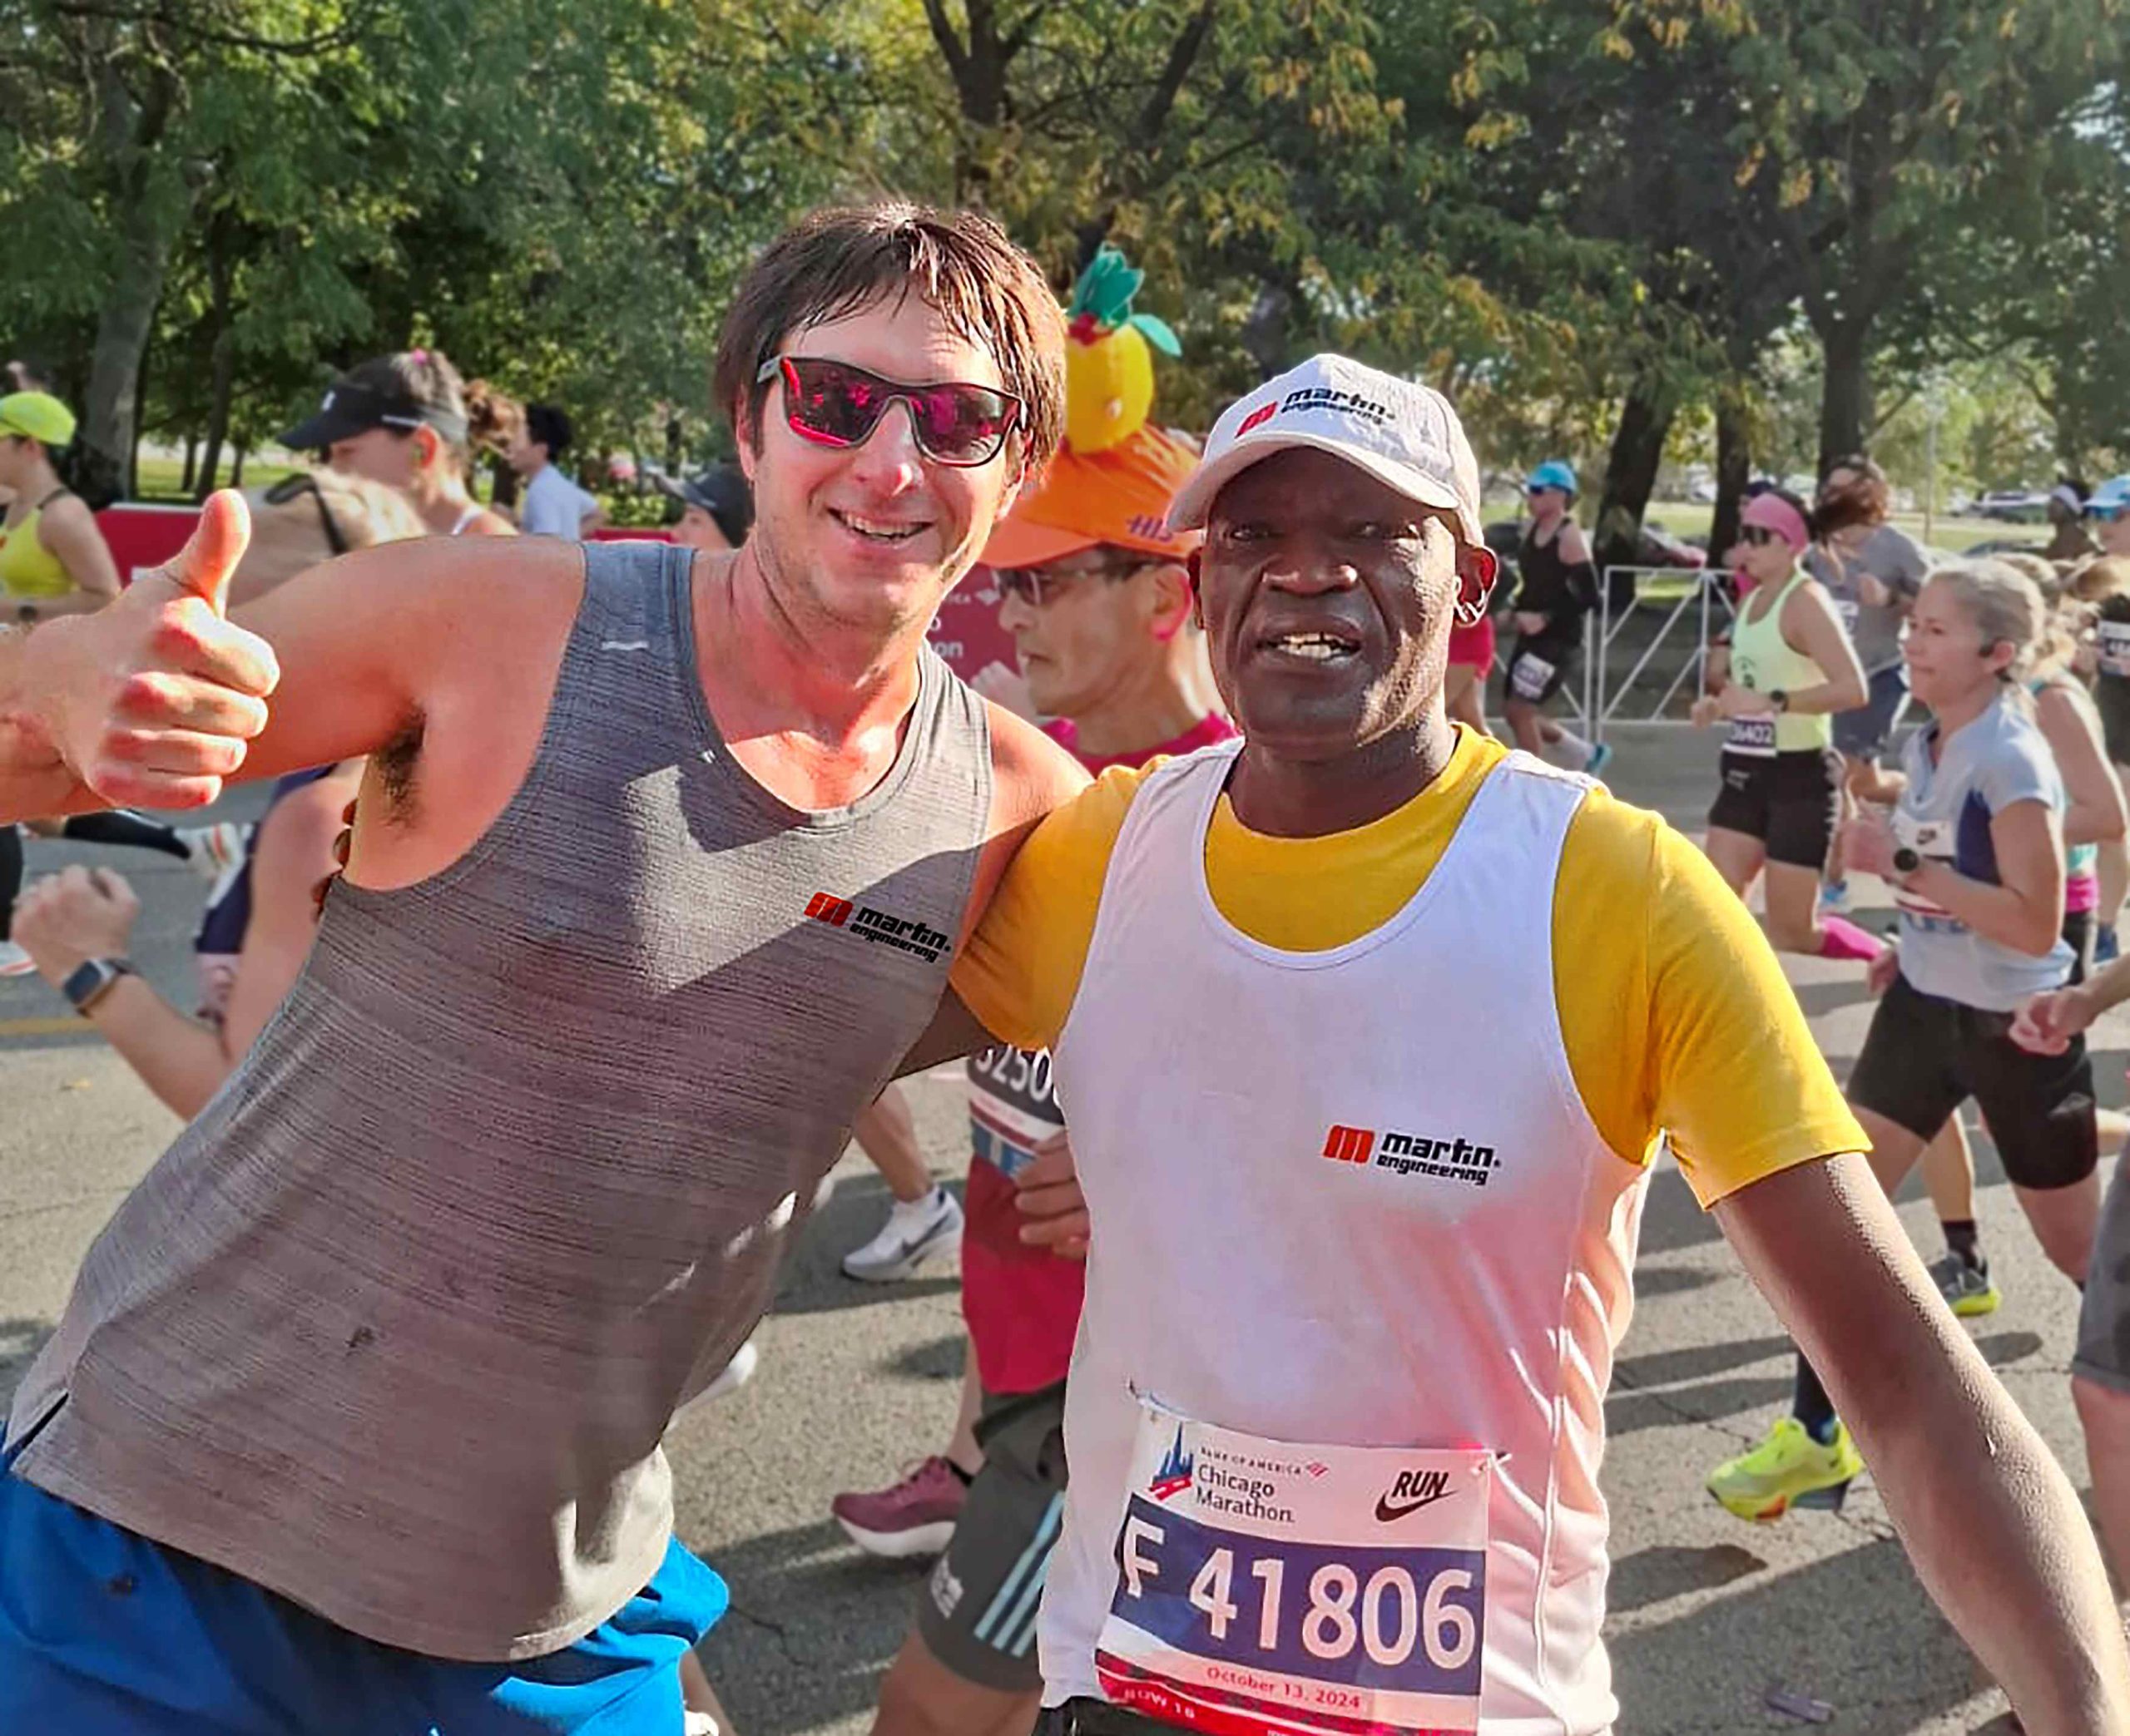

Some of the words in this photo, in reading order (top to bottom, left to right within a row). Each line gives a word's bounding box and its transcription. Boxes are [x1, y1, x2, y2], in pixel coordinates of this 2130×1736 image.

[850, 923, 939, 963] engineering
[1376, 1155, 1489, 1185] engineering
[1198, 1464, 1276, 1501] Chicago
[1249, 1460, 1301, 1475] AMERICA
[1391, 1470, 1449, 1497] RUN
[1122, 1514, 1165, 1599] F
[1189, 1548, 1476, 1670] 41806
[1206, 1666, 1276, 1694] October
[1316, 1689, 1362, 1709] 2024
